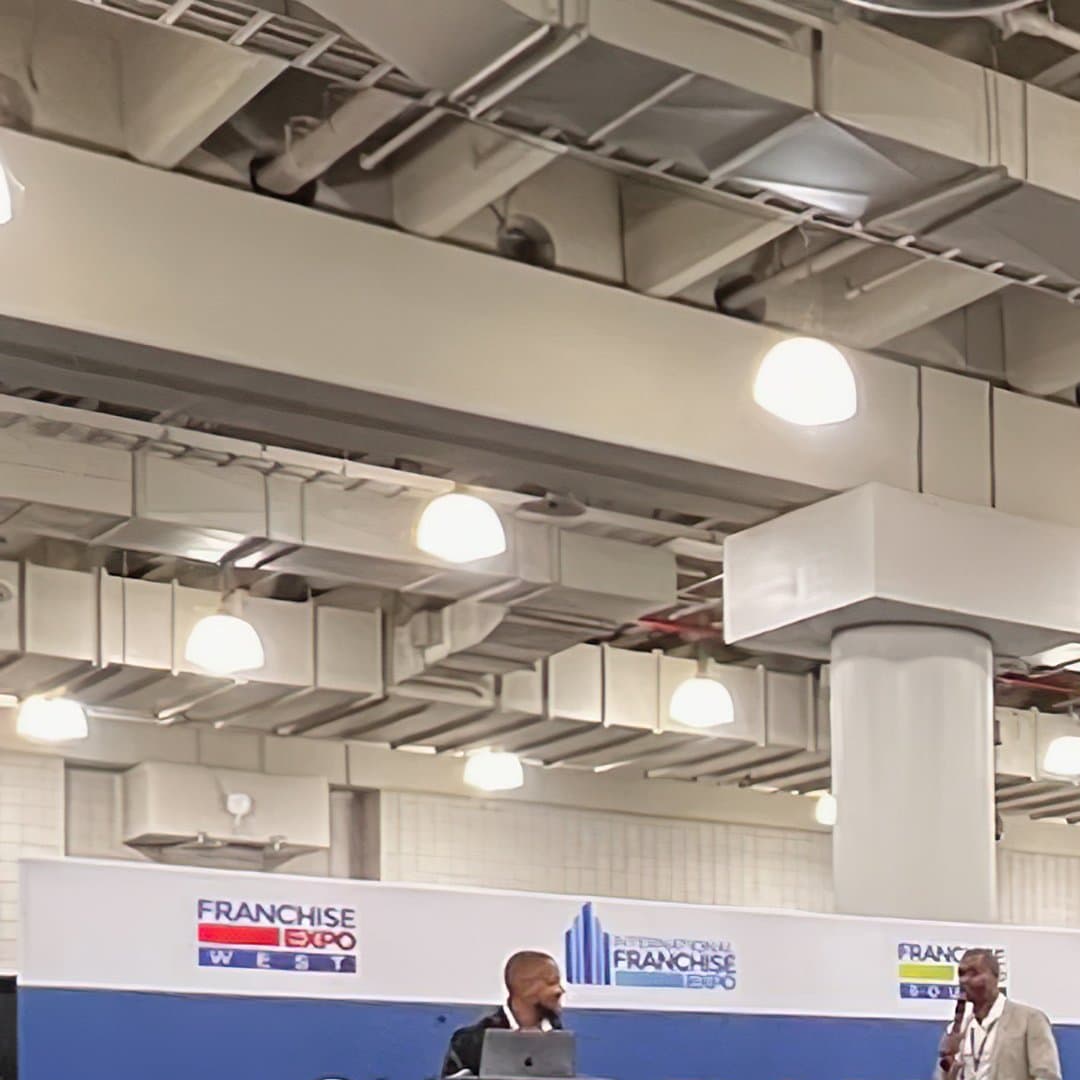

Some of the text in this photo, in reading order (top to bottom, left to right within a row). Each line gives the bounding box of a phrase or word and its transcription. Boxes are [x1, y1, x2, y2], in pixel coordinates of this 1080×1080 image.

[197, 898, 356, 928] FRANCHISE
[284, 928, 357, 950] EXPO
[208, 949, 346, 972] WEST
[613, 949, 737, 974] FRANCHISE
[897, 942, 1005, 963] FRANCE
